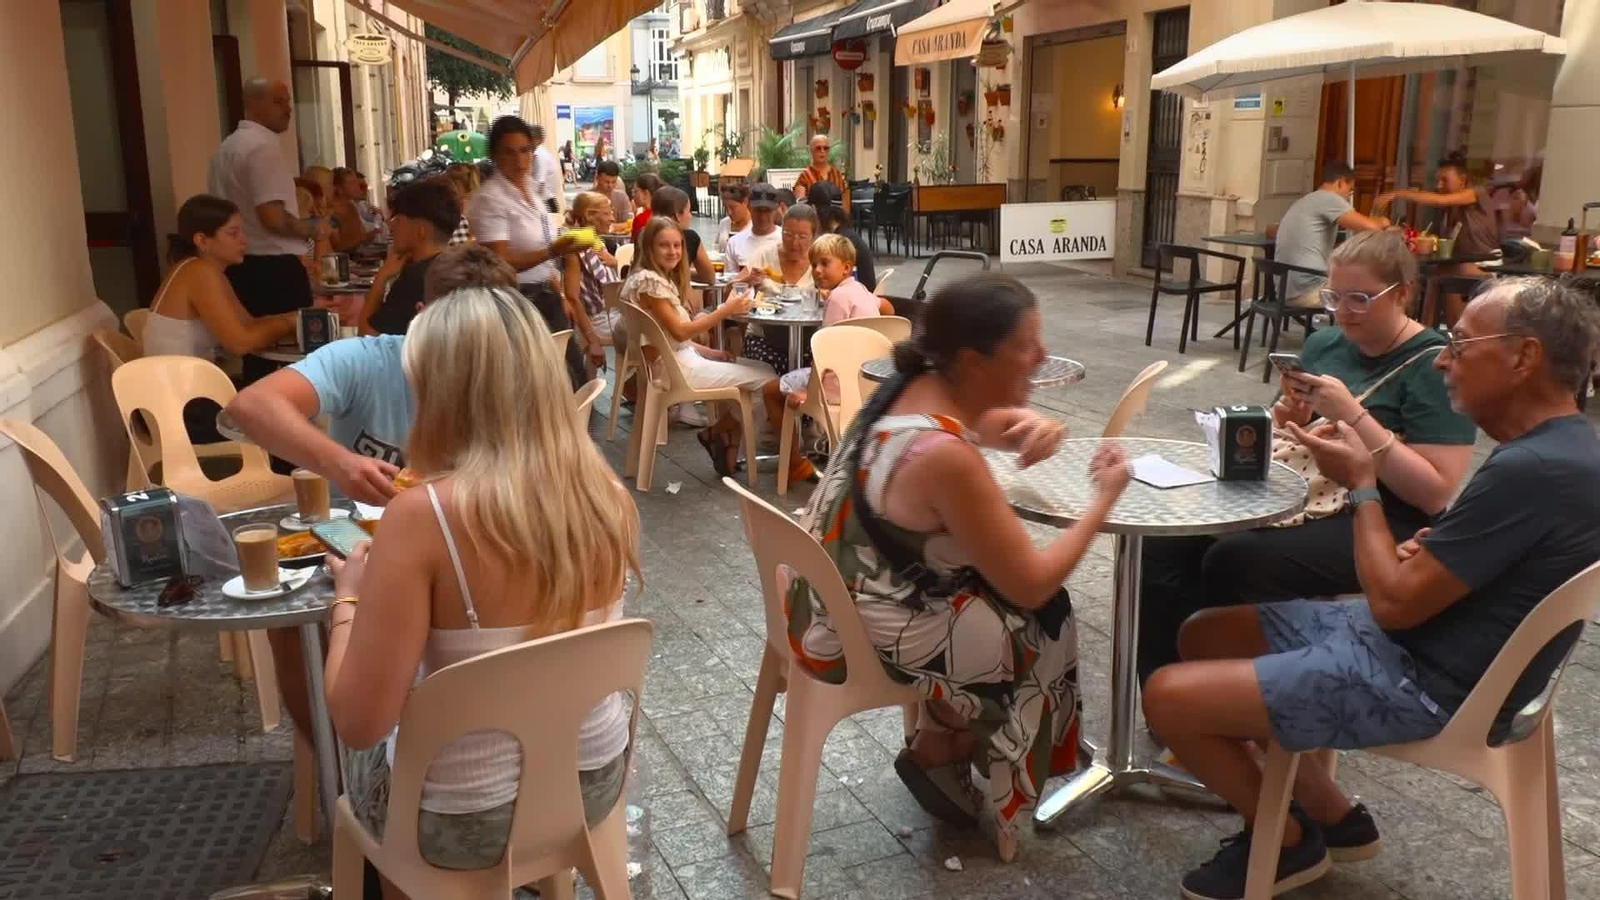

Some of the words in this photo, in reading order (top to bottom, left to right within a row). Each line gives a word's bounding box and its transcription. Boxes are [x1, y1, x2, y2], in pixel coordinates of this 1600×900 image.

[912, 39, 931, 55] CASA
[933, 31, 967, 53] ARANDA
[1009, 238, 1045, 256] CASA
[1052, 235, 1107, 254] ARANDA
